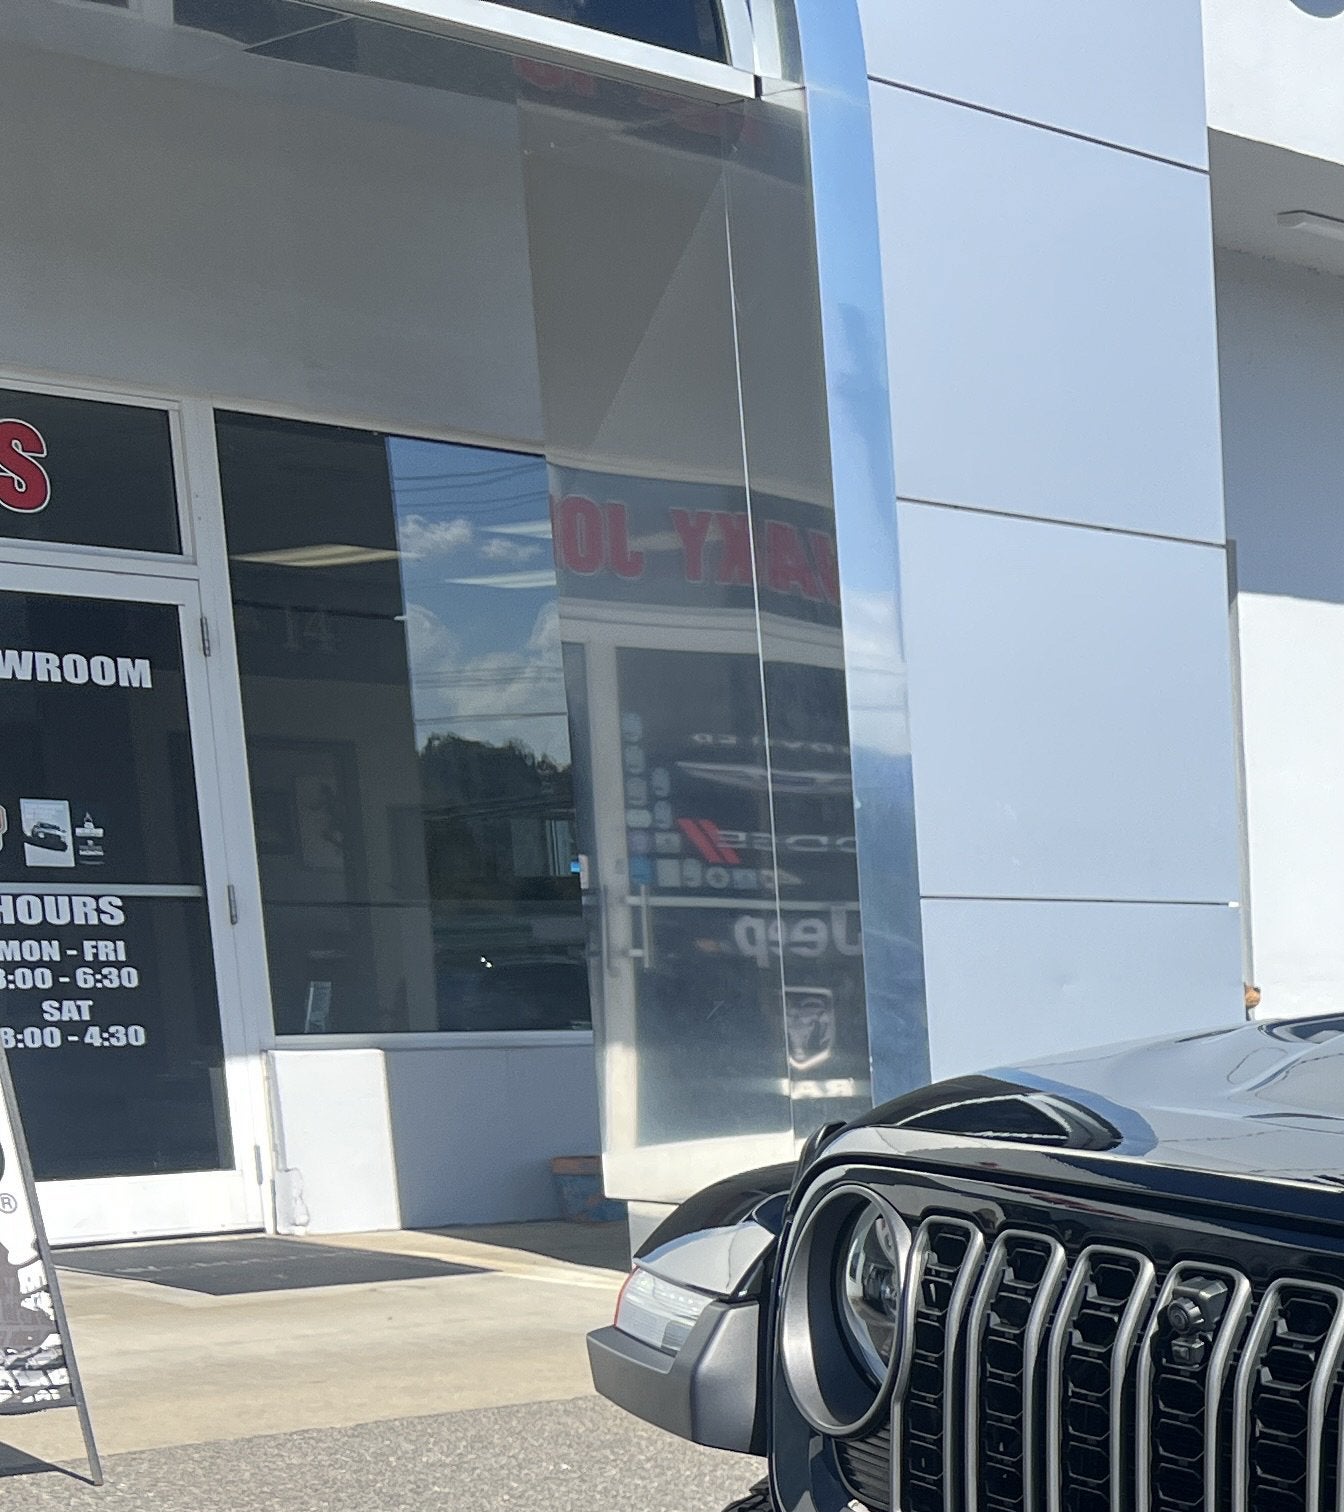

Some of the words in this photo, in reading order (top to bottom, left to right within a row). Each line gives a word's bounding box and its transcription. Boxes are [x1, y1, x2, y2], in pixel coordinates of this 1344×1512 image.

[83, 940, 127, 962] FRI
[75, 966, 139, 989] 6:30
[41, 999, 94, 1022] SAT
[84, 1024, 146, 1047] 4:30
